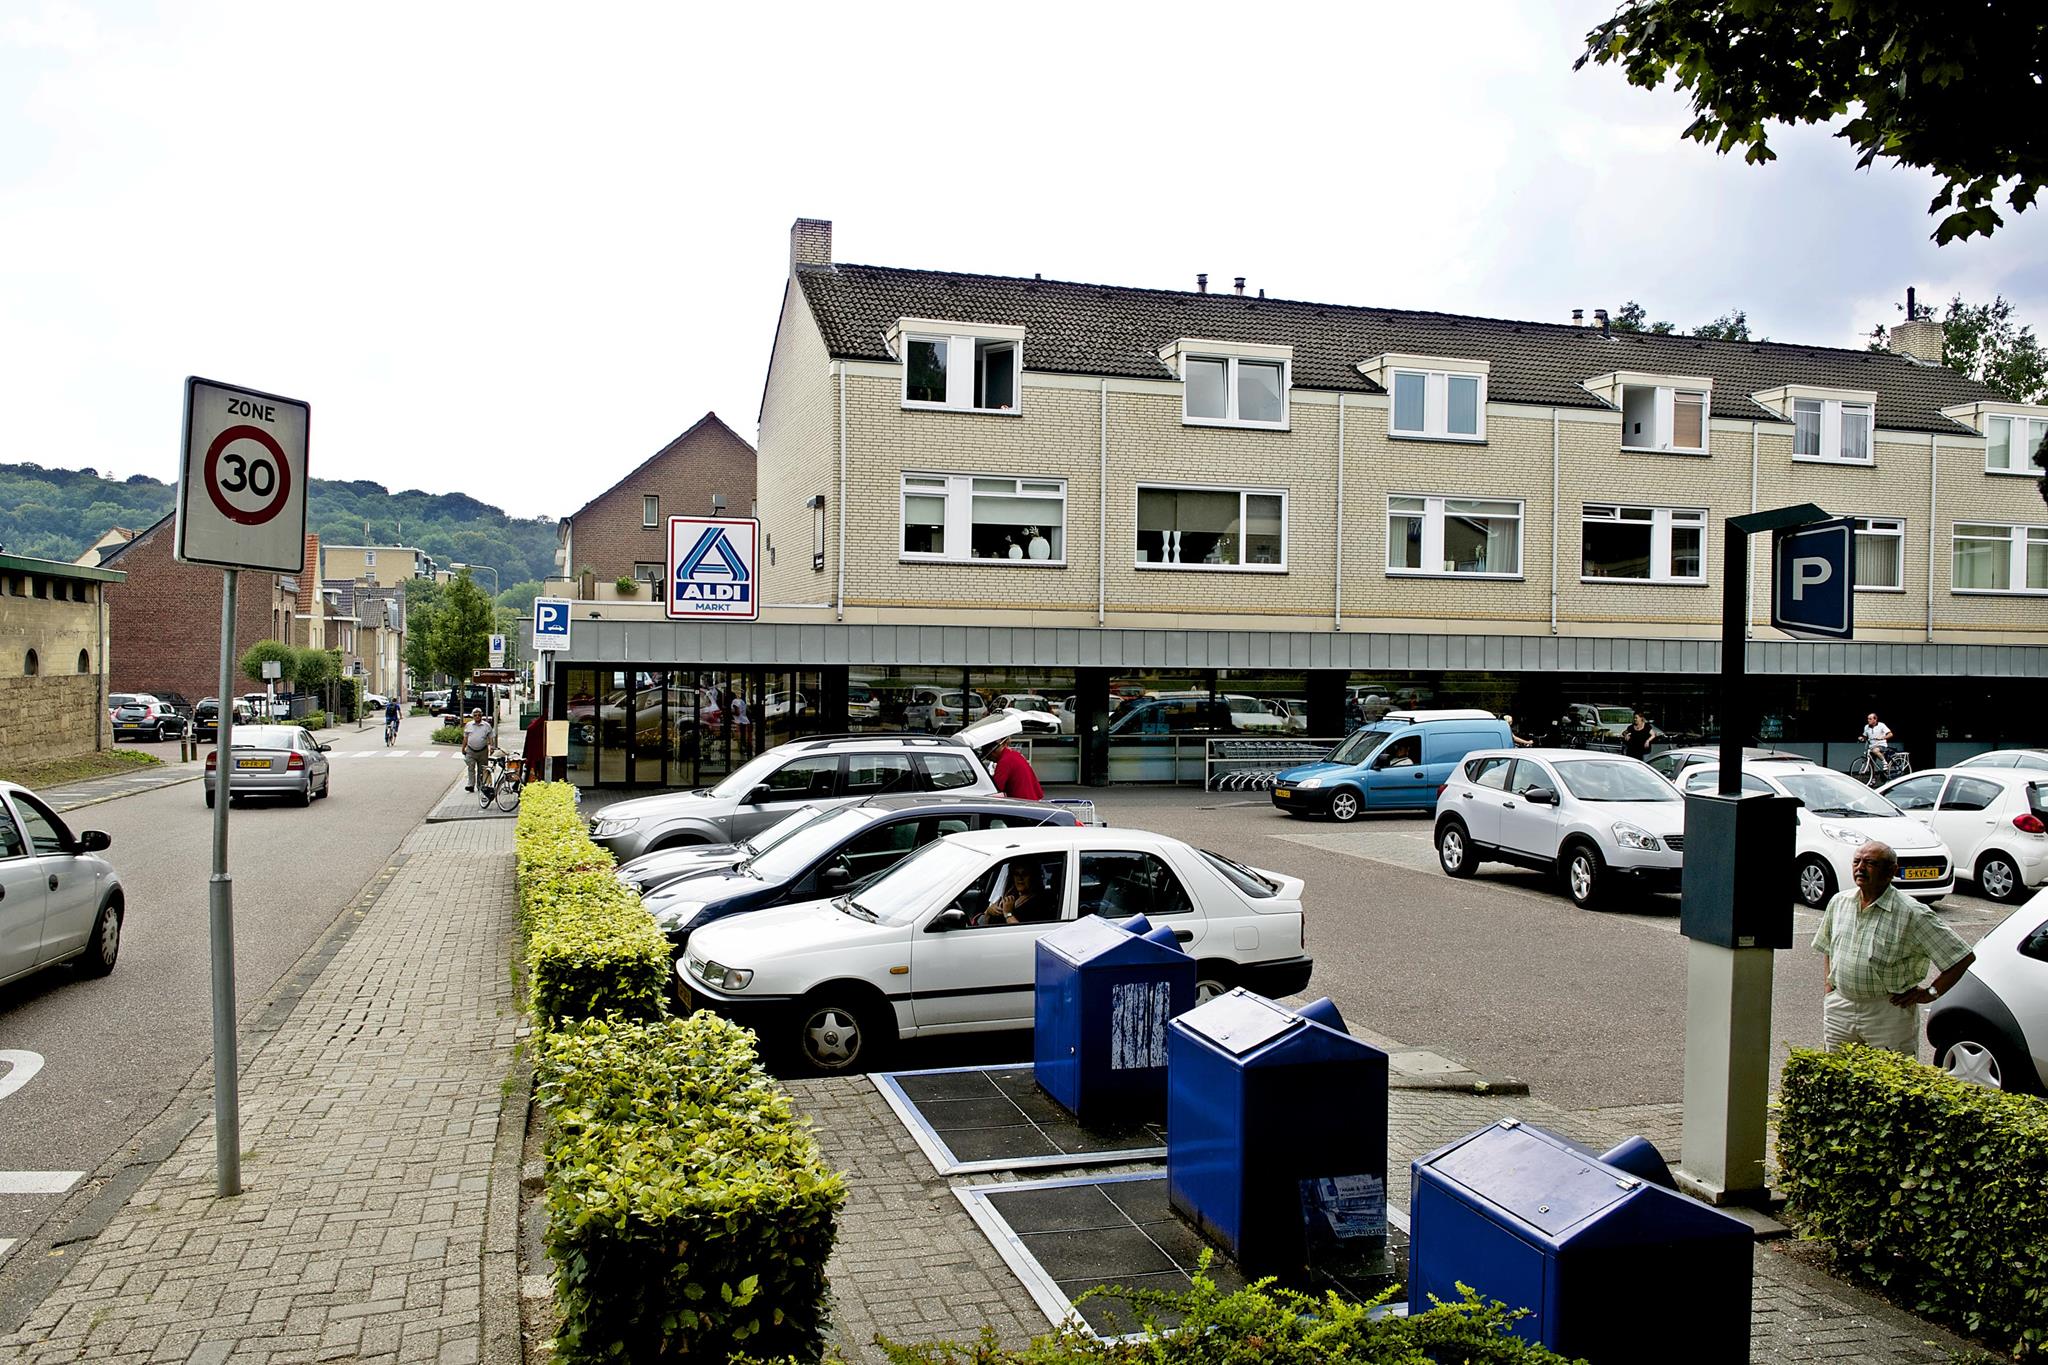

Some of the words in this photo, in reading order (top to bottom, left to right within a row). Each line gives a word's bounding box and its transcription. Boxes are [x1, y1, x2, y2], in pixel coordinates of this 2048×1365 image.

[227, 398, 275, 422] ZONE
[220, 454, 275, 497] 30
[1792, 556, 1832, 601] P
[682, 583, 741, 600] ALDI
[539, 606, 558, 631] P
[695, 603, 731, 612] MARKT
[1908, 869, 1937, 878] 5-KVZ-41
